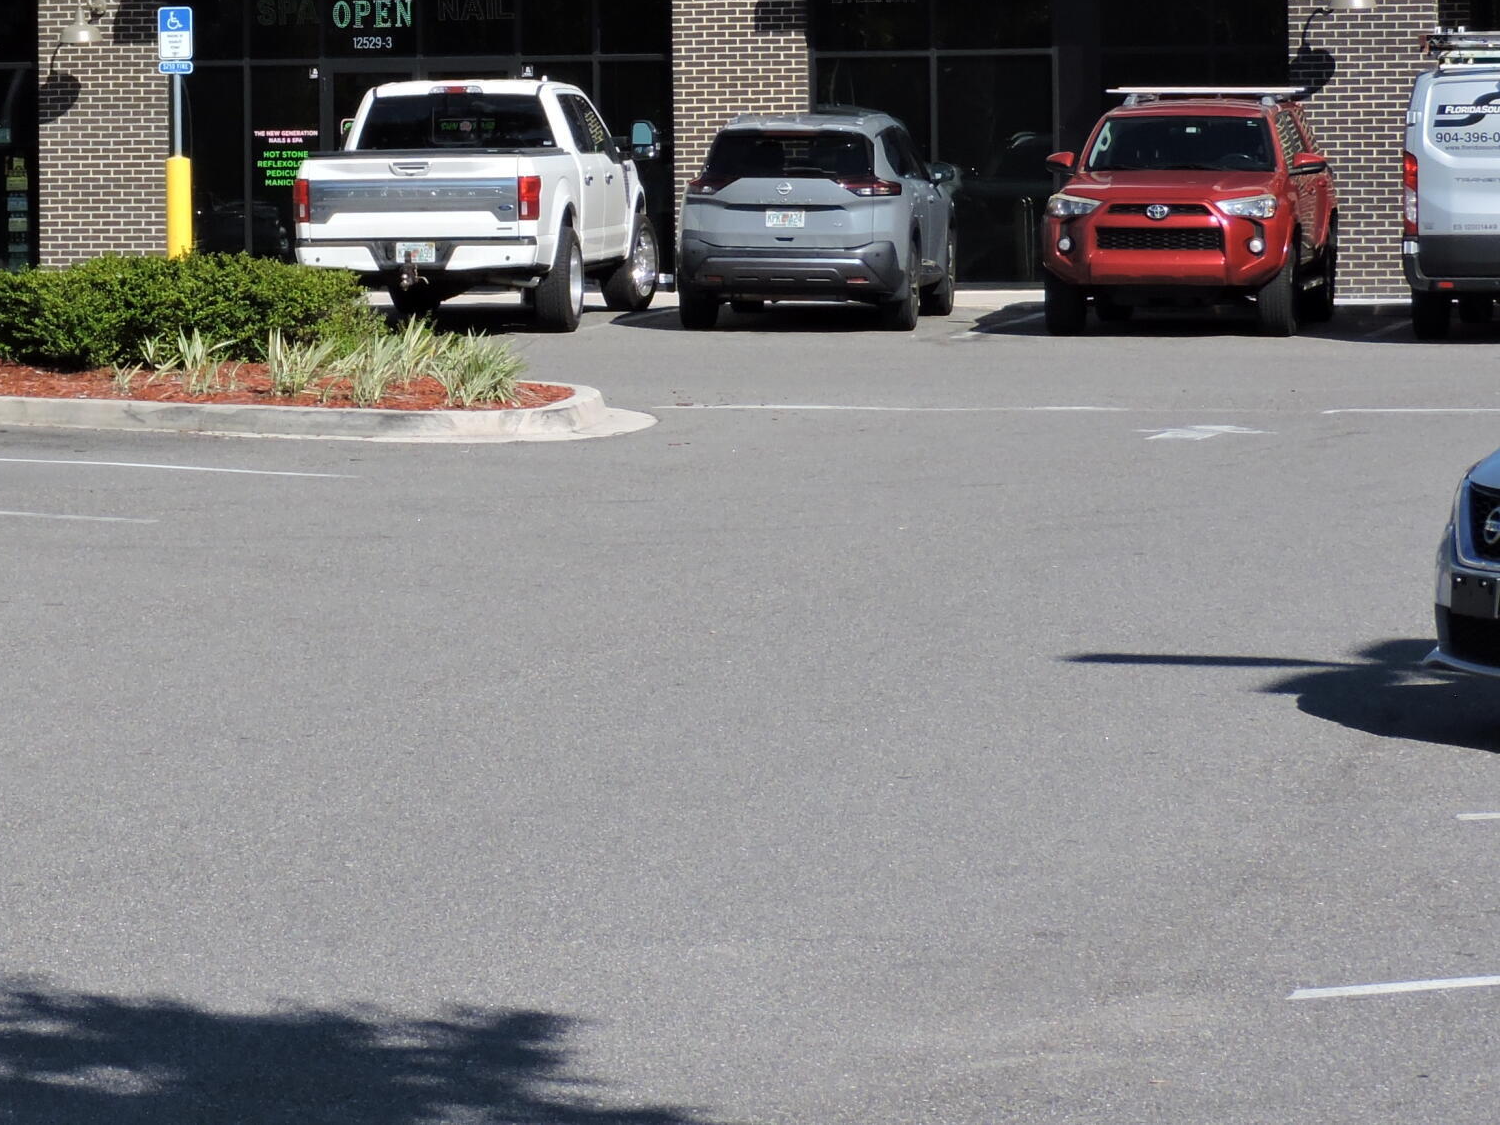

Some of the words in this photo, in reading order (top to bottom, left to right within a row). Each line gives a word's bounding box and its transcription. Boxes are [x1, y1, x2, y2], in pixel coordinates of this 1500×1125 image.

[332, 0, 413, 28] OPEN
[353, 36, 393, 49] 12529-3
[282, 150, 309, 158] STONE
